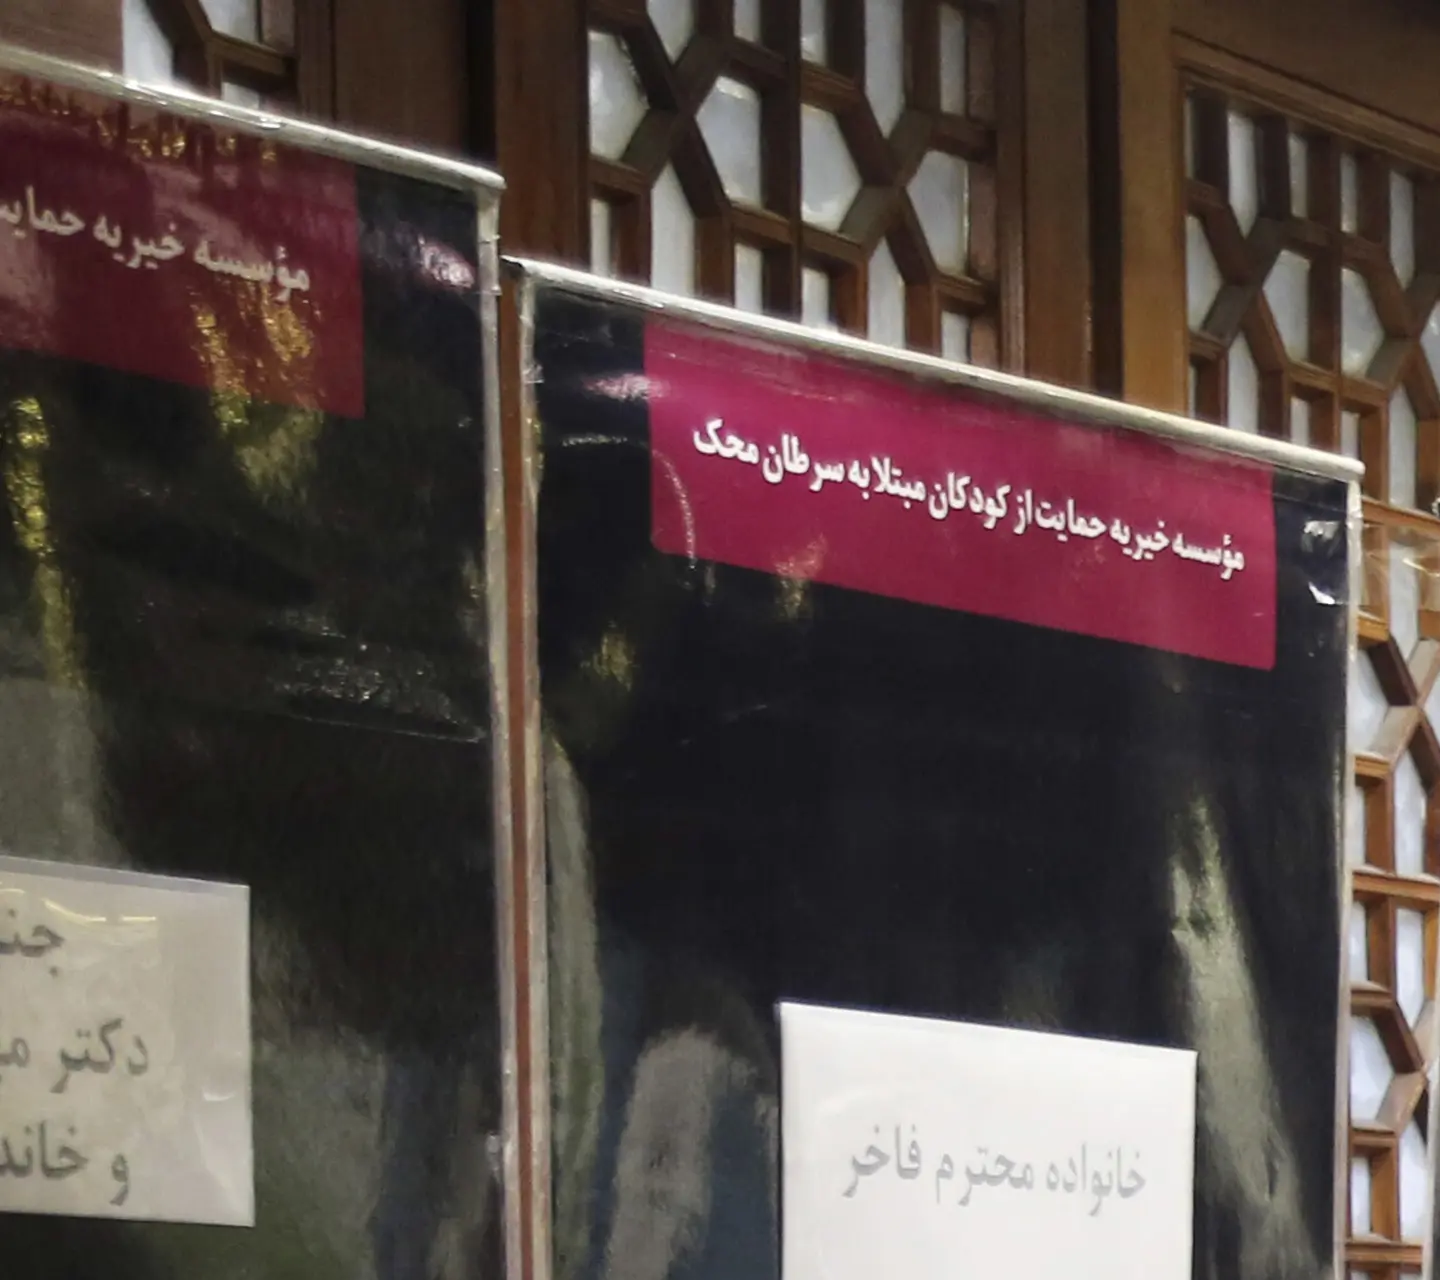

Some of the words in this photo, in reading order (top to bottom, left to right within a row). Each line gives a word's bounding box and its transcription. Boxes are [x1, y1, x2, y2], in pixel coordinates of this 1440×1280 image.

[0, 185, 86, 238] حمای
[92, 215, 186, 270] خیریه
[193, 240, 310, 301] مؤسسه
[693, 418, 759, 464] محک
[762, 433, 845, 492] سرطان
[848, 459, 870, 500] به
[871, 456, 926, 509] مبتلا
[929, 472, 1011, 529] کودکان
[1013, 489, 1032, 535] از
[1034, 498, 1107, 542] حمایت
[1109, 518, 1169, 560] خیریه
[1172, 532, 1245, 580] مؤسسه
[49, 1017, 149, 1094] دکتر
[108, 1153, 130, 1206] و
[841, 1123, 922, 1200] فاخر
[935, 1146, 1034, 1207] محترم
[1046, 1142, 1146, 1217] خانواده
